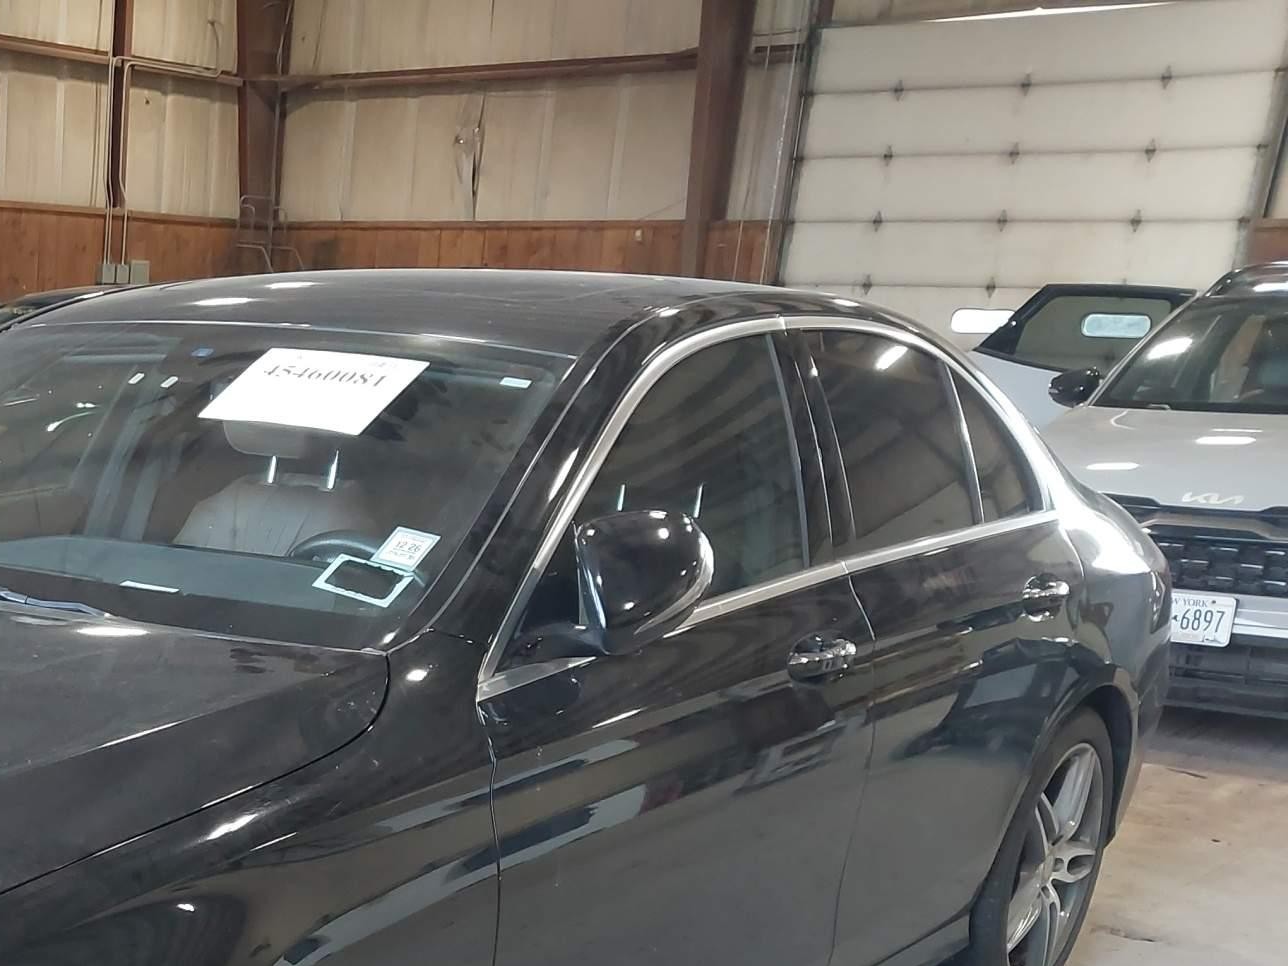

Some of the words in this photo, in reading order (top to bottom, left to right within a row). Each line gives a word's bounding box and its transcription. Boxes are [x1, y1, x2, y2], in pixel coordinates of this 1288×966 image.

[263, 364, 387, 387] 45460081
[1183, 597, 1208, 608] YORK
[1179, 608, 1226, 633] 6897
